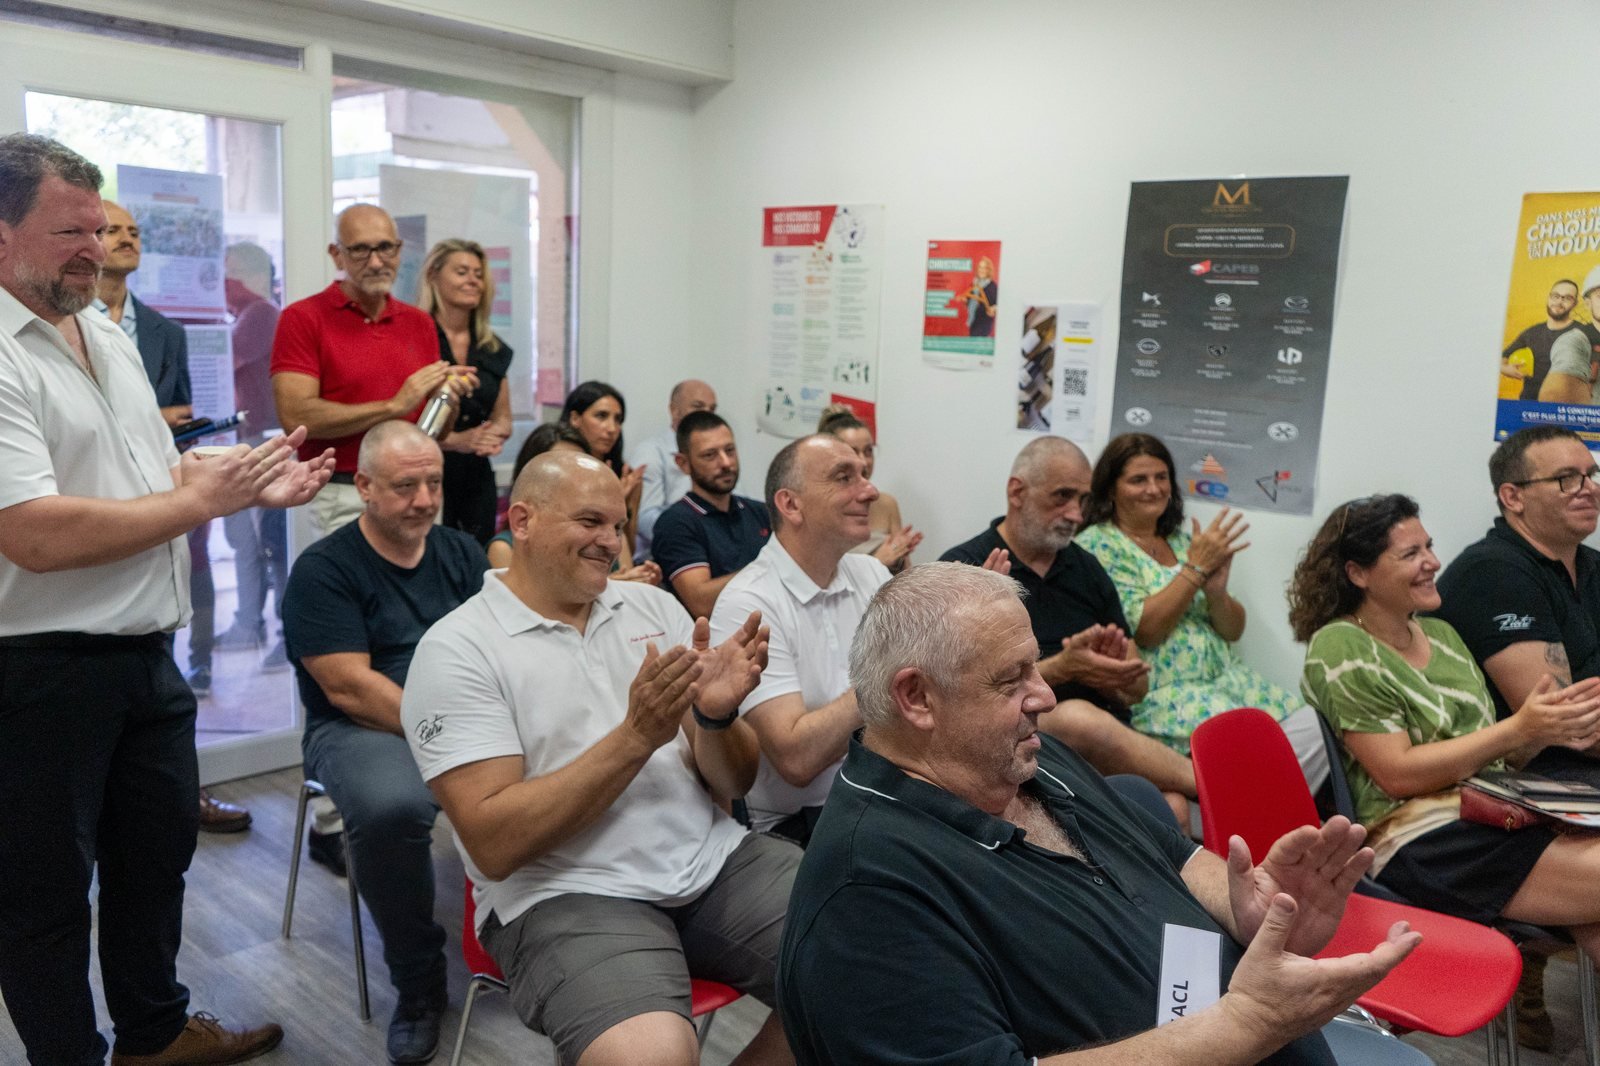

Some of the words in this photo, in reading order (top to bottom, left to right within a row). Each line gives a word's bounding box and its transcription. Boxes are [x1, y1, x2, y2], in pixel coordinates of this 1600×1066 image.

[1537, 211, 1563, 224] DANS
[1566, 208, 1586, 220] NOS
[1170, 980, 1189, 1021] ACL
